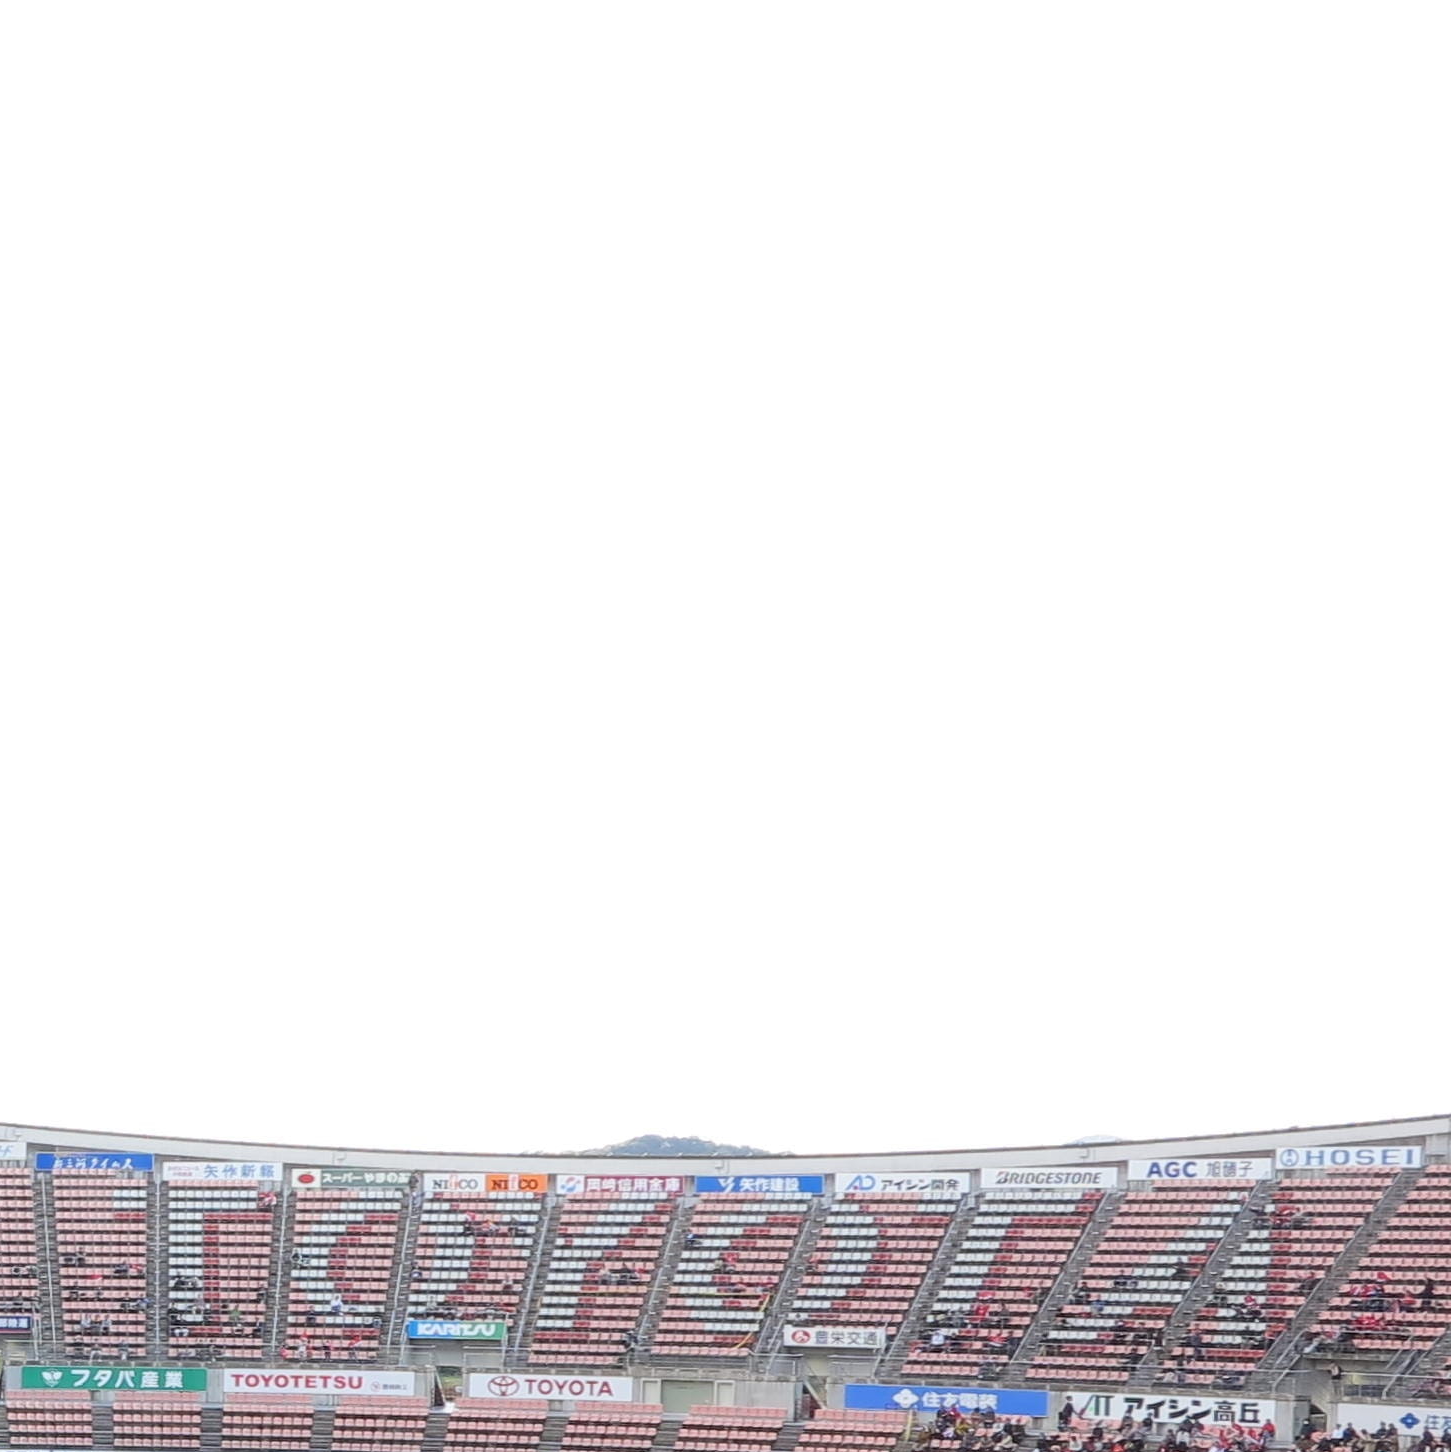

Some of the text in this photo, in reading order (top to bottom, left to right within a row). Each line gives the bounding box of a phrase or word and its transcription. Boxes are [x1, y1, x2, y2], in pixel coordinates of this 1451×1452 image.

[1305, 1148, 1414, 1166] HOSEI
[1146, 1161, 1198, 1178] AGC
[585, 1177, 679, 1192] 岡崎信用金庫
[738, 1177, 800, 1192] 矢作建設
[880, 1179, 960, 1191] アイシン開発
[995, 1171, 1102, 1185] BRIDGESTONE
[69, 1369, 183, 1389] フタバ産業
[230, 1374, 364, 1389] TOYOTETSU
[524, 1379, 614, 1397] TOYOTA
[1121, 1397, 1260, 1425] アイシン高丘
